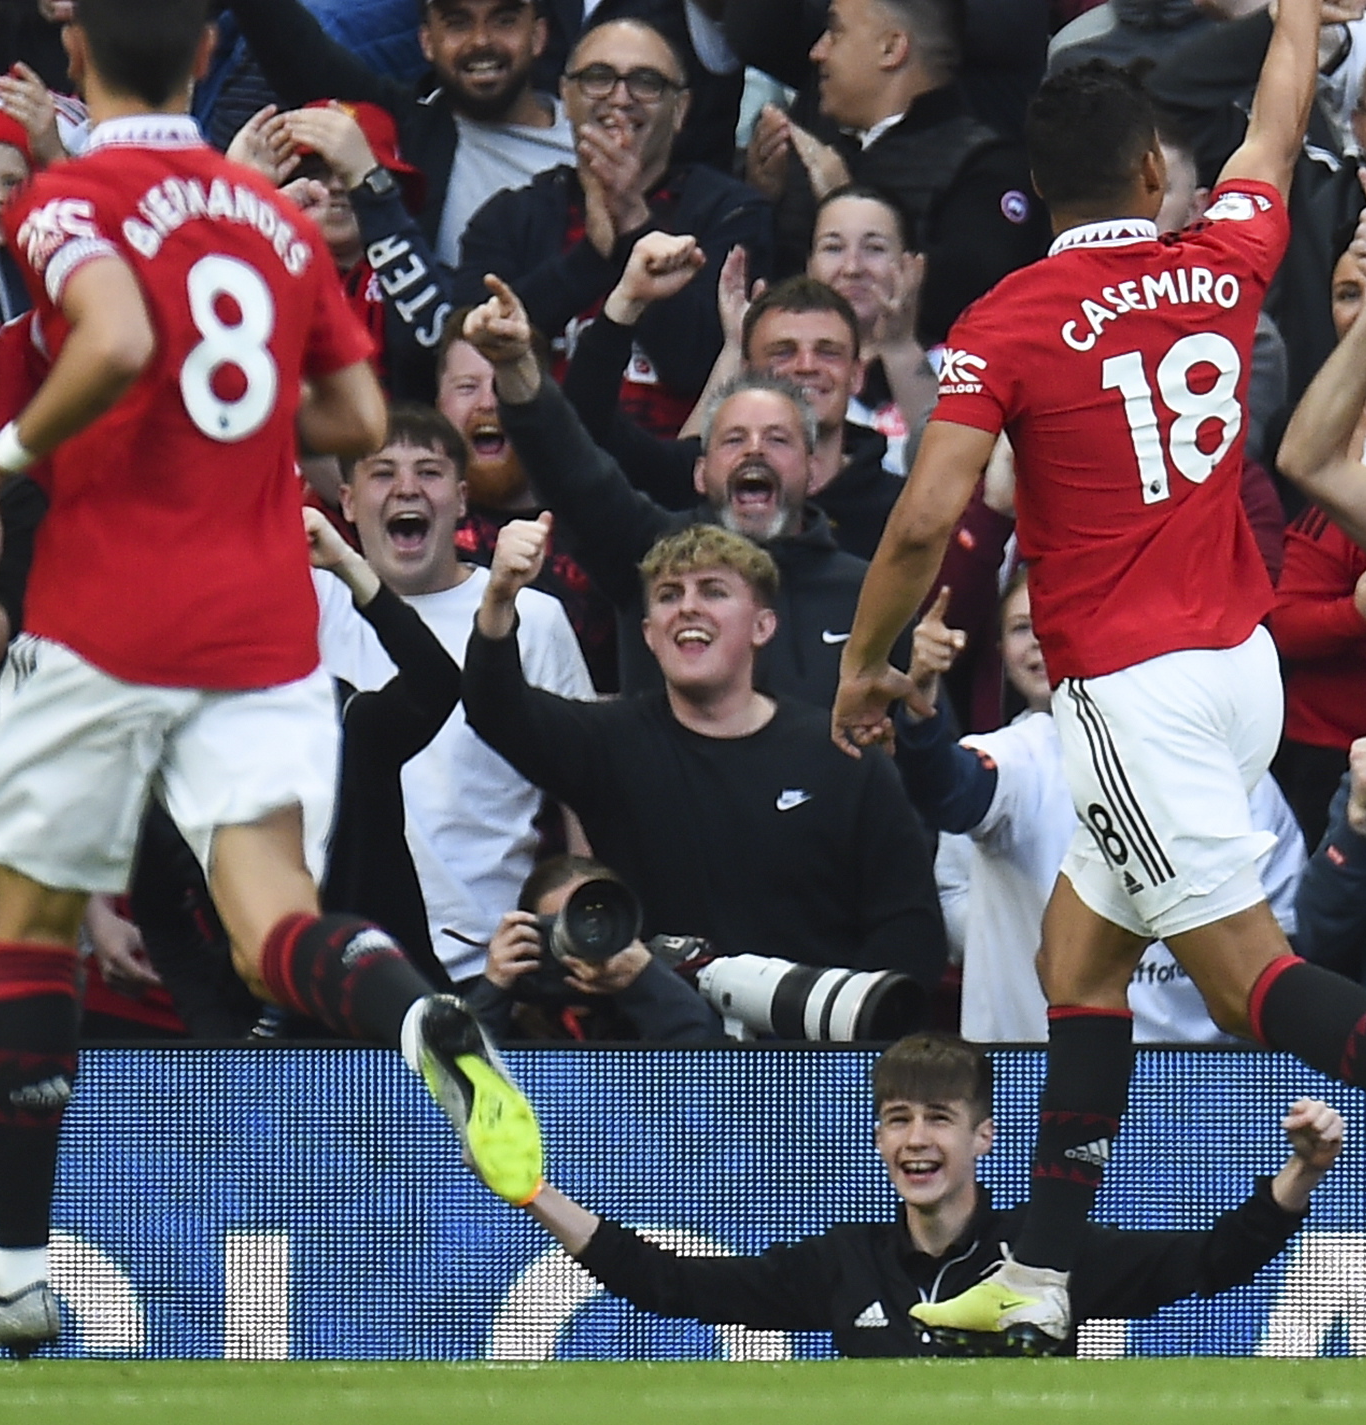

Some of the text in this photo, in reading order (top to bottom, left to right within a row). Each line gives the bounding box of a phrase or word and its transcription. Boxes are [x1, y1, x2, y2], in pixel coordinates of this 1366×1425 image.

[180, 253, 280, 443] 8
[367, 235, 452, 347] STER
[1062, 267, 1240, 351] CASEMIRO
[1102, 332, 1242, 505] 18
